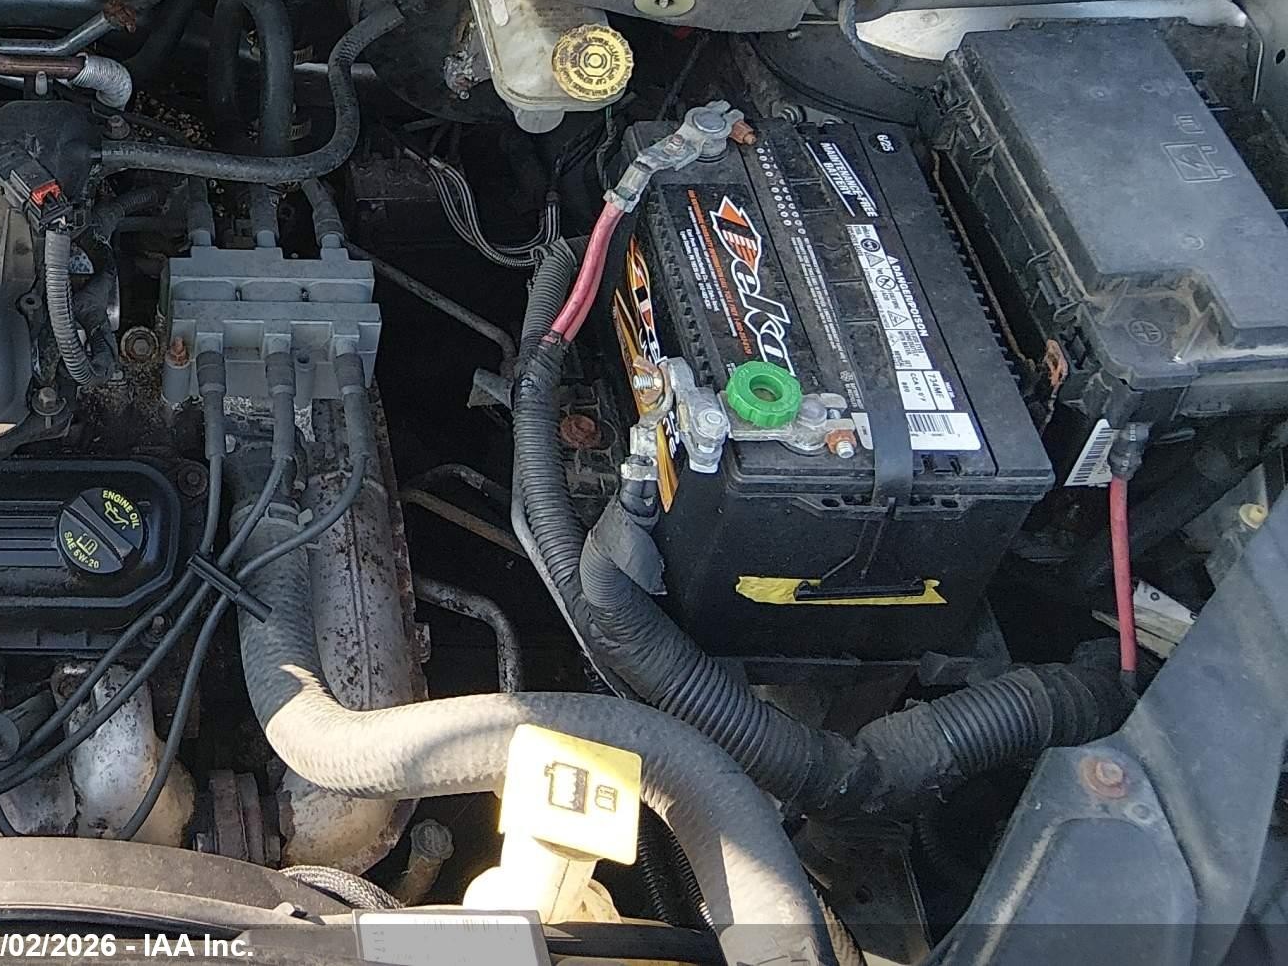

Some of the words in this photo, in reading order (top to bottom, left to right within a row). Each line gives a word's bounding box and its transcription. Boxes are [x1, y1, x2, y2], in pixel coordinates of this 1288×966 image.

[818, 142, 878, 217] MAINTENANCE-FREE
[821, 162, 853, 195] BATTERY
[102, 490, 133, 514] ENGINE
[130, 512, 140, 529] OIL
[64, 531, 76, 550] SAE
